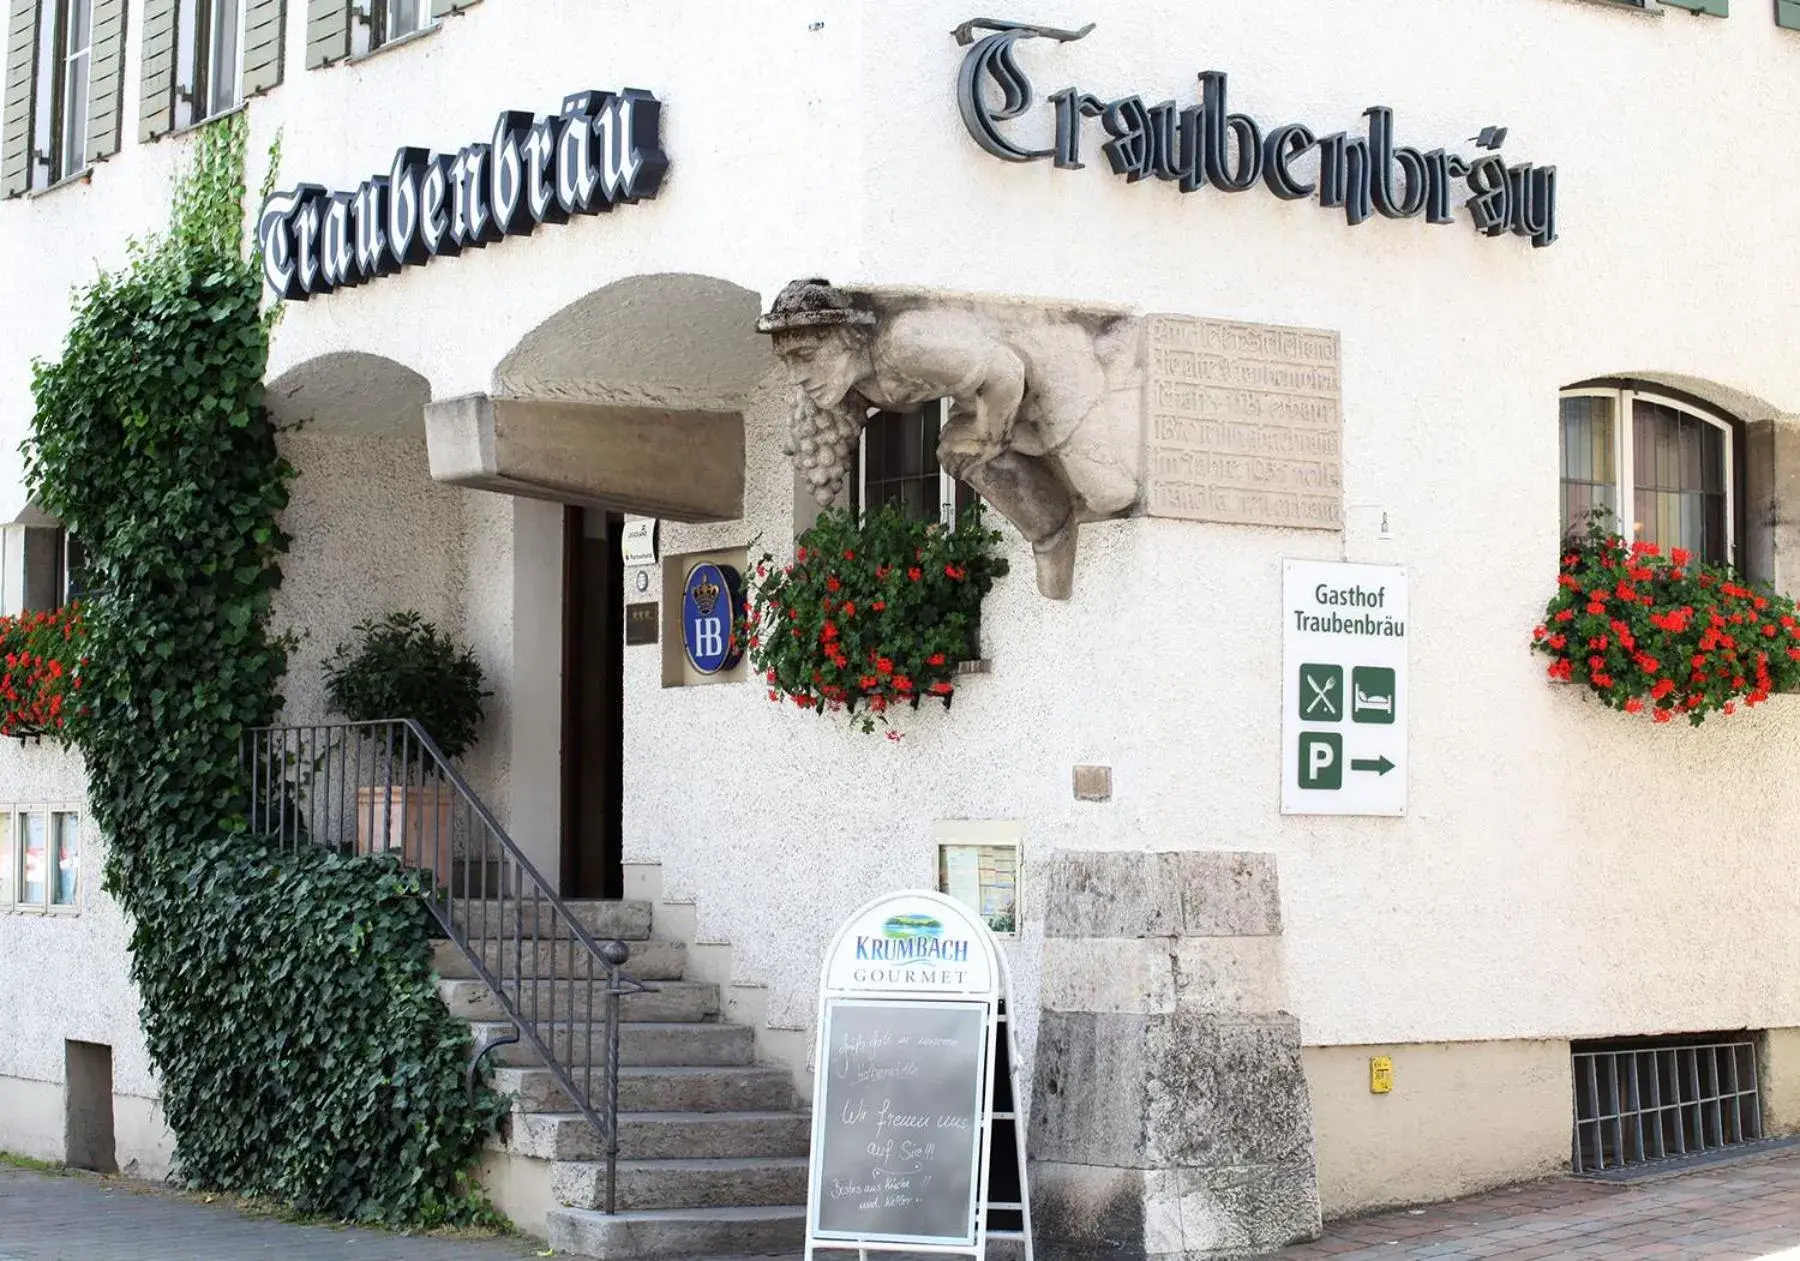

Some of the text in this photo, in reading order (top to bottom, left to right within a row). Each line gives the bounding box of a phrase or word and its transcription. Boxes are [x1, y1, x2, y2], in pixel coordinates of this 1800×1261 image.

[951, 17, 1559, 248] Traubenbräu
[258, 88, 668, 301] Traubenbräu
[1314, 583, 1385, 608] Gasthof
[694, 616, 722, 657] HB
[1294, 610, 1405, 637] Traubenbräu
[1308, 741, 1335, 781] P
[856, 936, 969, 962] KRUMBACH
[853, 968, 968, 984] GOURMET
